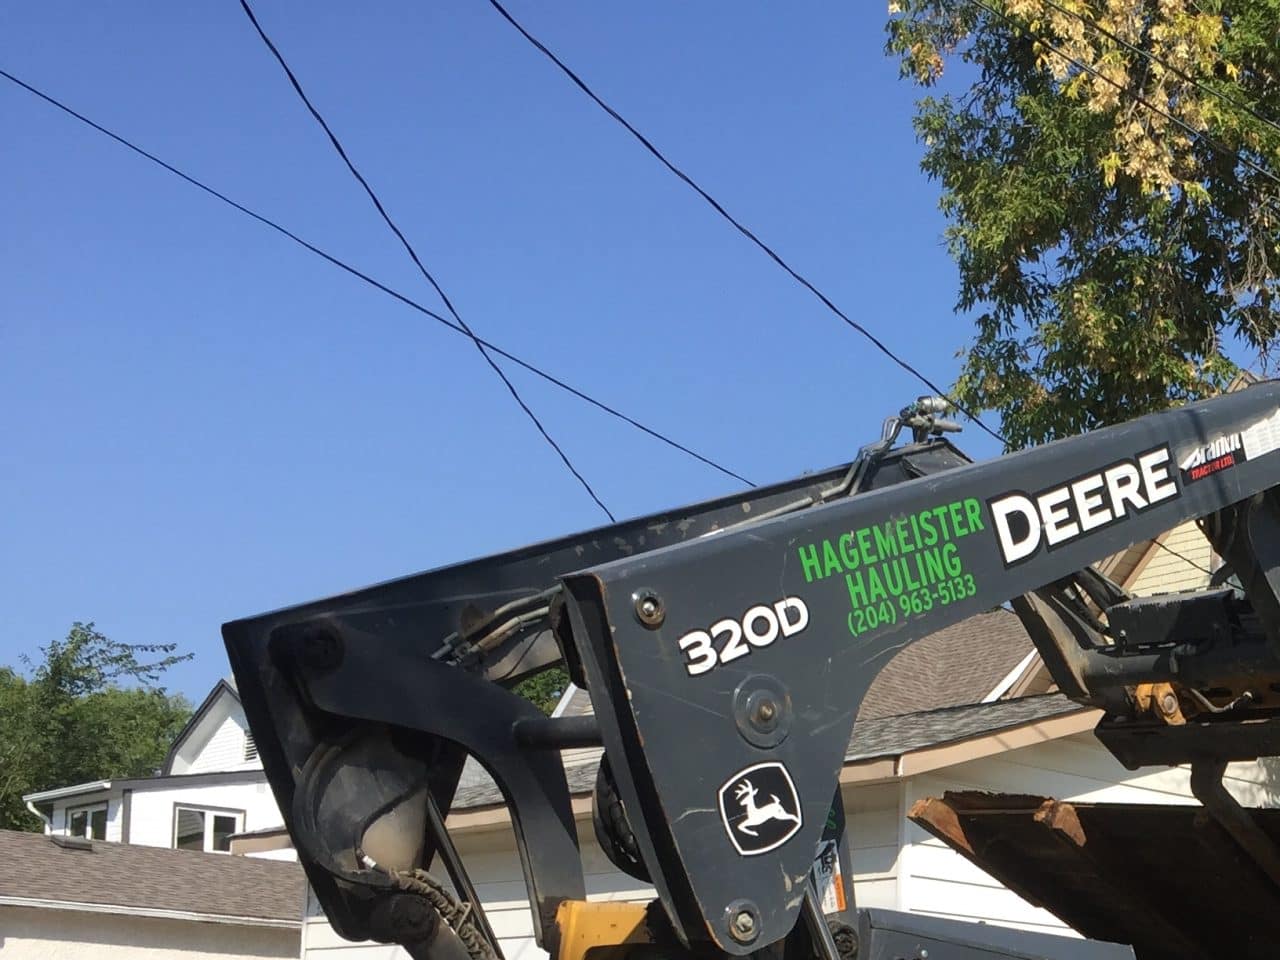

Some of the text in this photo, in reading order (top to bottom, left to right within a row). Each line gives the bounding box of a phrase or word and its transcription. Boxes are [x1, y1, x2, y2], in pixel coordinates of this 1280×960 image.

[798, 498, 985, 583] HAGEMEISTER
[990, 447, 1178, 564] DEERE
[845, 542, 963, 609] HAULING
[848, 573, 977, 638] (204) 963-5133
[678, 595, 810, 676] 320D
